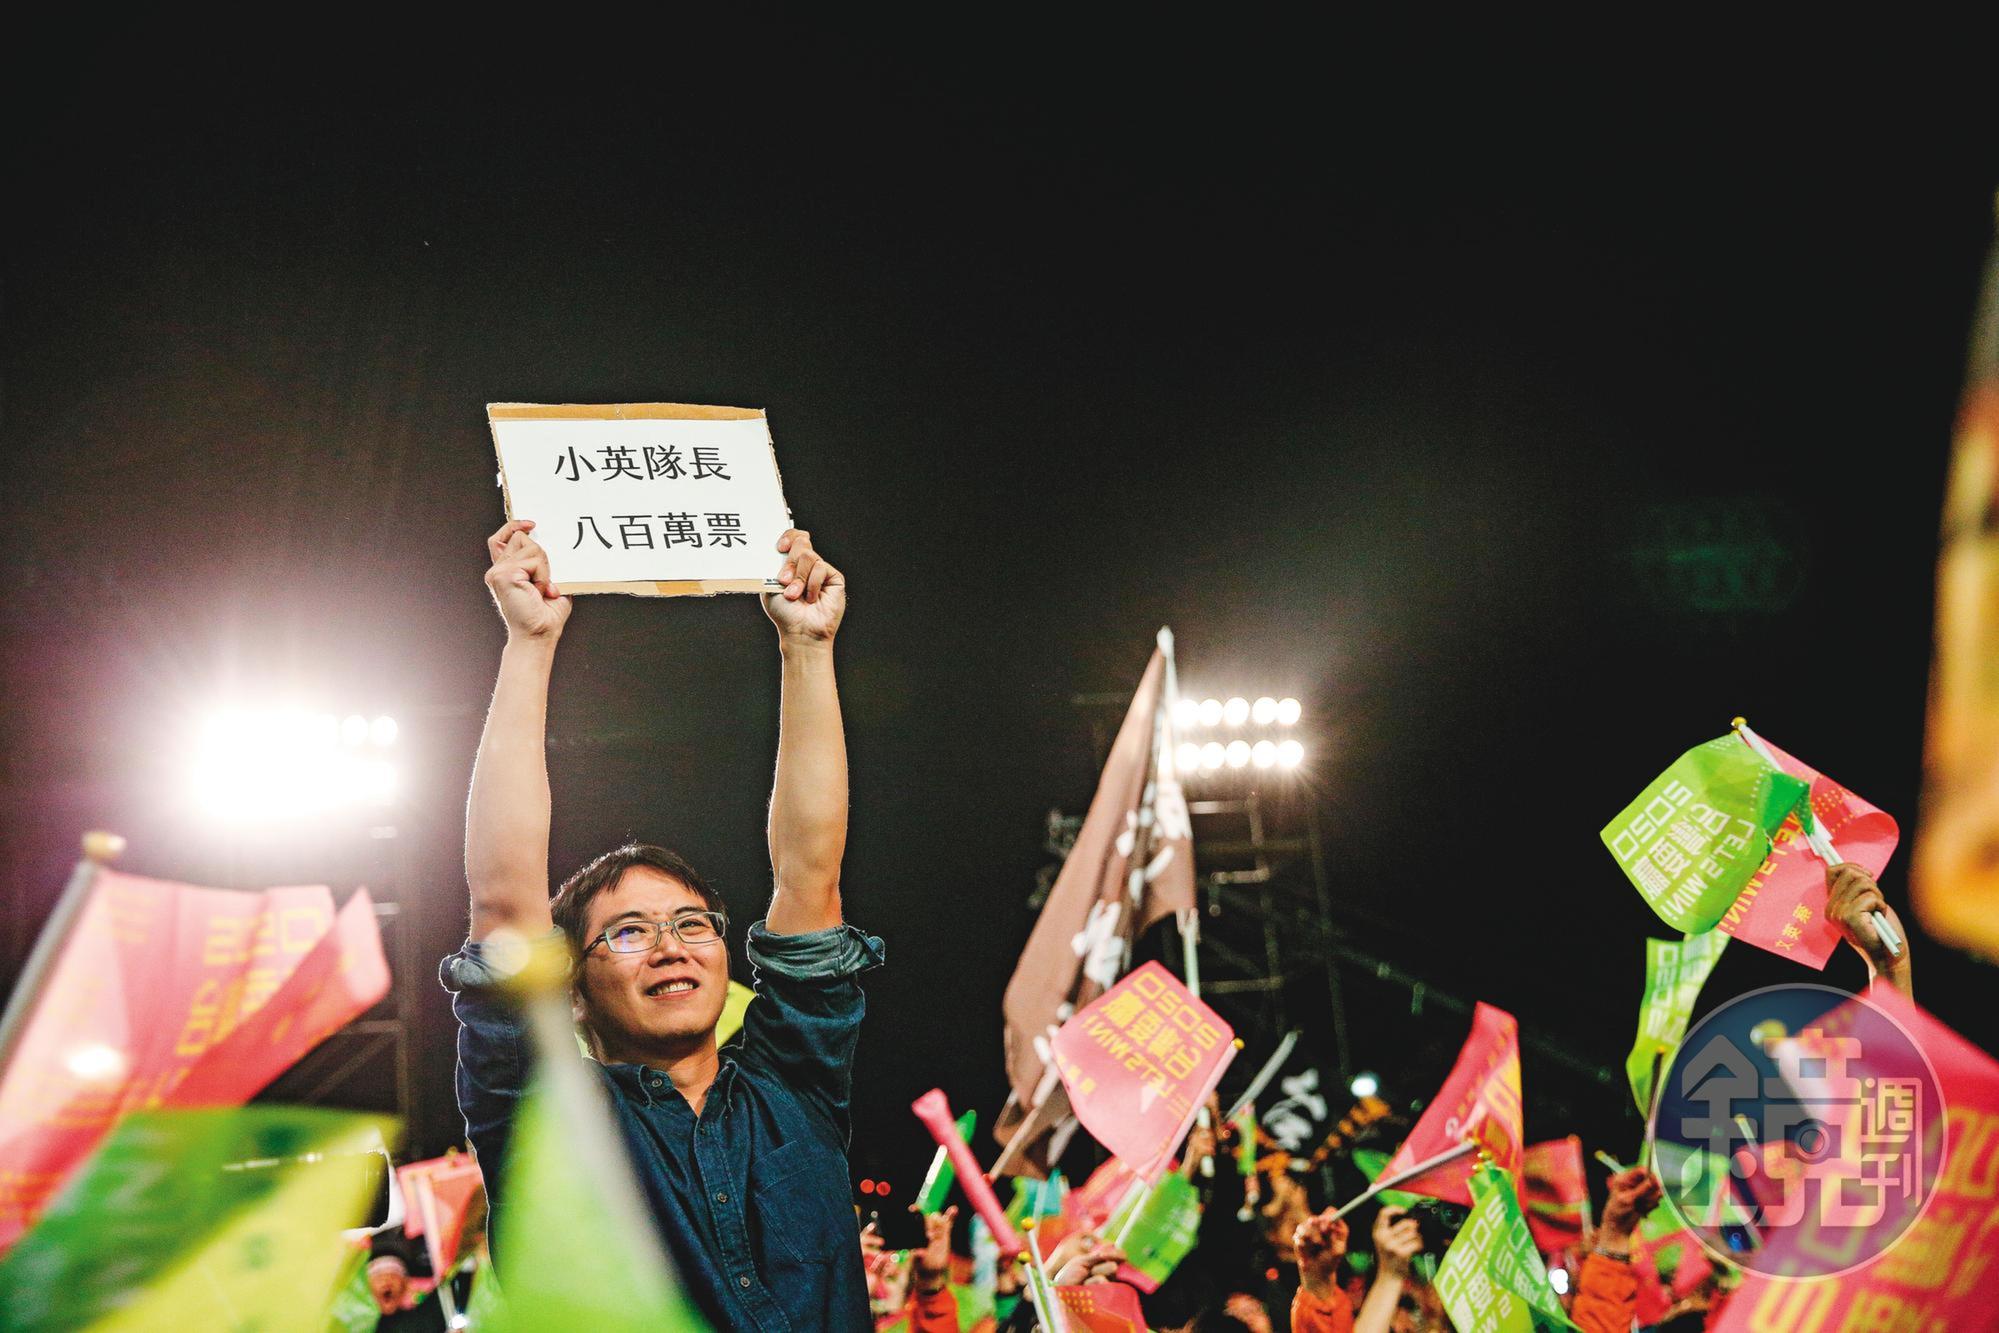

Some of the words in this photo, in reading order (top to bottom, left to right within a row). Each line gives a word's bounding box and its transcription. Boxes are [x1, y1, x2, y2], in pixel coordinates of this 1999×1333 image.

[554, 444, 732, 482] 小英隊長
[572, 511, 748, 550] 八百萬票
